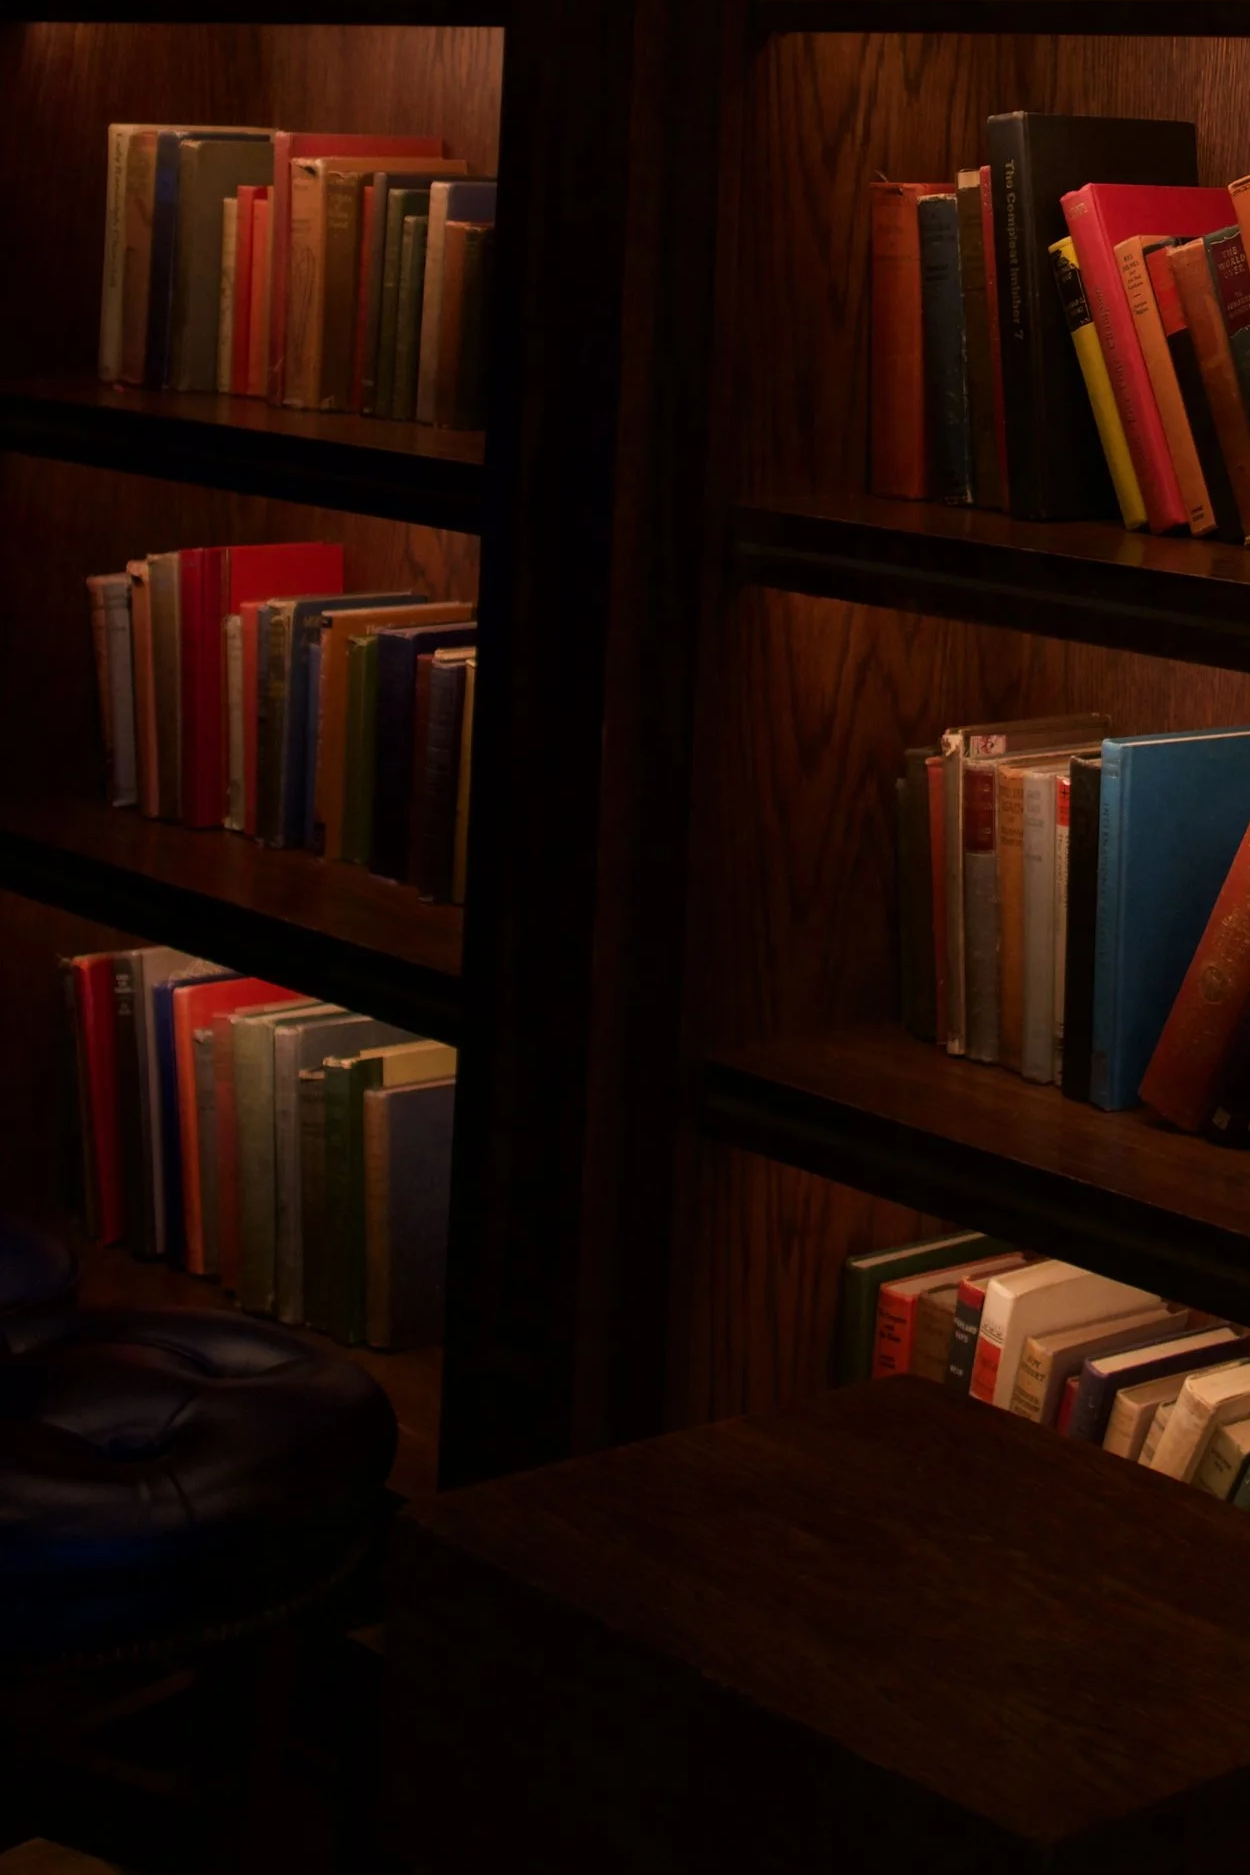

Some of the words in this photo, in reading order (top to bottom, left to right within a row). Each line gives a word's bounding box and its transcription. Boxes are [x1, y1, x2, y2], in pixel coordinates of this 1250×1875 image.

[1004, 159, 1015, 189] The
[1221, 244, 1238, 259] THE
[1218, 254, 1246, 271] WORLD
